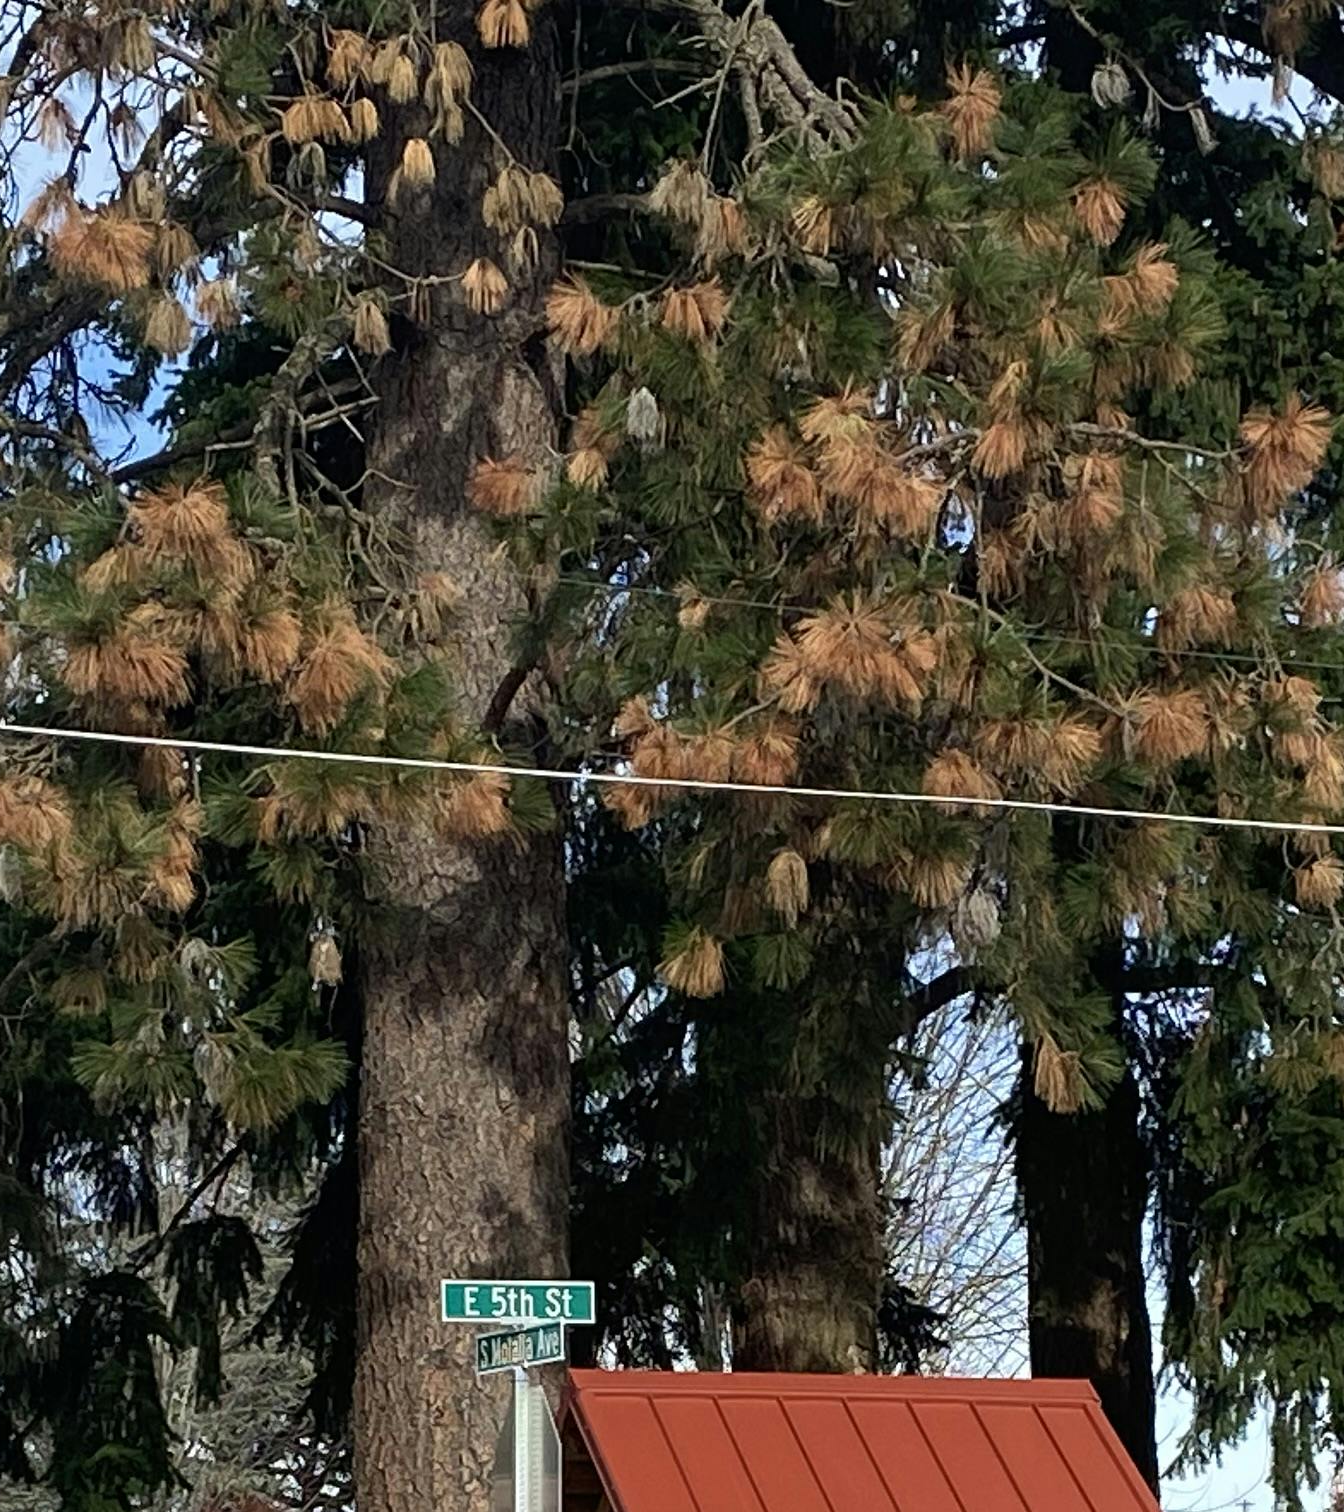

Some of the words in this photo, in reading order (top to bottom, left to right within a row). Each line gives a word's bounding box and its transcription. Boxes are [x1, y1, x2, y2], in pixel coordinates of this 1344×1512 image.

[463, 1286, 479, 1317] E
[491, 1286, 534, 1318] 5th
[545, 1287, 573, 1318] St
[480, 1339, 489, 1367] S
[491, 1332, 534, 1366] Molalla
[537, 1327, 560, 1358] Ave
